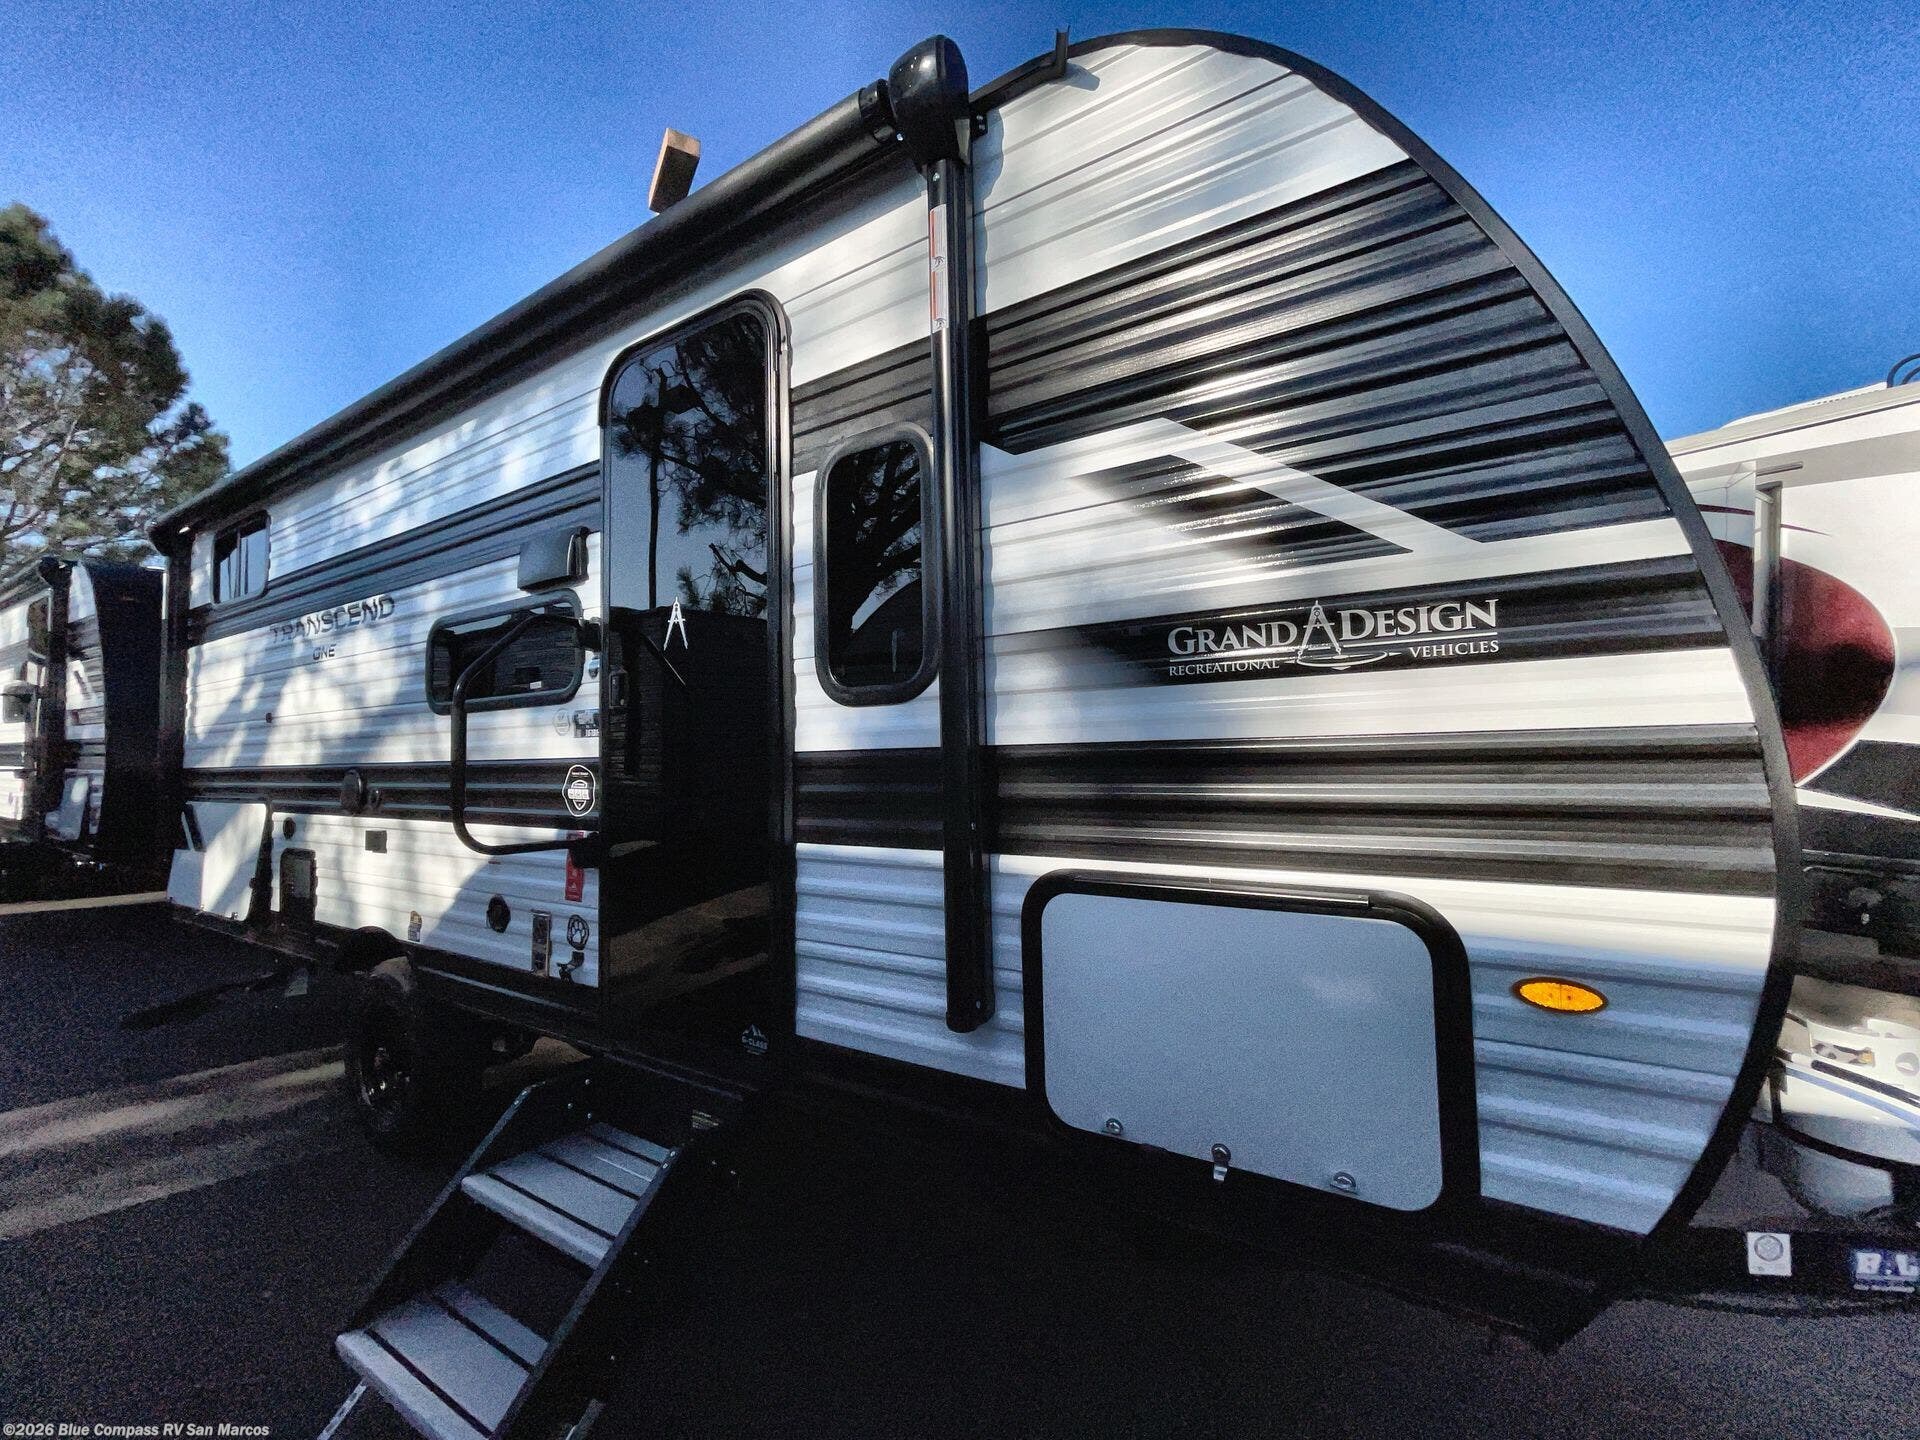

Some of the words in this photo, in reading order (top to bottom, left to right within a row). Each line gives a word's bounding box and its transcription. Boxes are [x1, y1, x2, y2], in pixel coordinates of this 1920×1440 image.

[269, 592, 396, 643] TRANSCEND
[1168, 621, 1298, 655] GRAND
[1337, 599, 1499, 639] DESIGN
[312, 643, 337, 661] ONE
[1169, 659, 1280, 676] RECREATIONAL
[1409, 640, 1500, 658] VEHICLES
